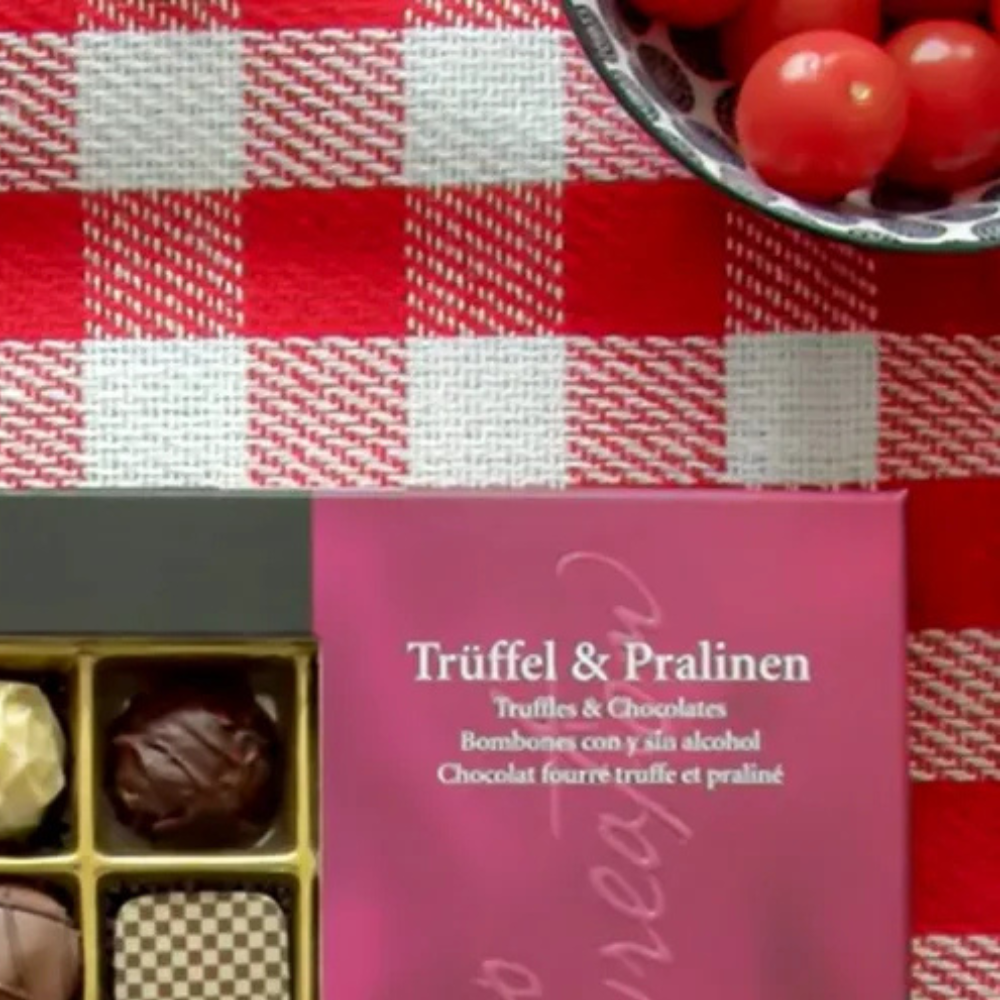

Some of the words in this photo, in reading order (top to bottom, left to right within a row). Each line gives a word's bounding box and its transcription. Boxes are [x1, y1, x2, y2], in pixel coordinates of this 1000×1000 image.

[407, 641, 557, 682] Trüffel
[571, 641, 609, 681] &
[625, 641, 811, 682] Pralinen
[494, 696, 578, 718] Truffles
[582, 698, 602, 718] &
[607, 696, 727, 719] Chocolates
[460, 729, 576, 751] Bombones
[581, 735, 621, 751] con
[625, 735, 640, 757] y
[644, 729, 677, 751] sin
[682, 729, 761, 751] alcohol
[437, 762, 535, 784] Chocolat
[615, 762, 677, 784] truffe
[681, 767, 701, 784] et
[706, 763, 784, 790] praliné
